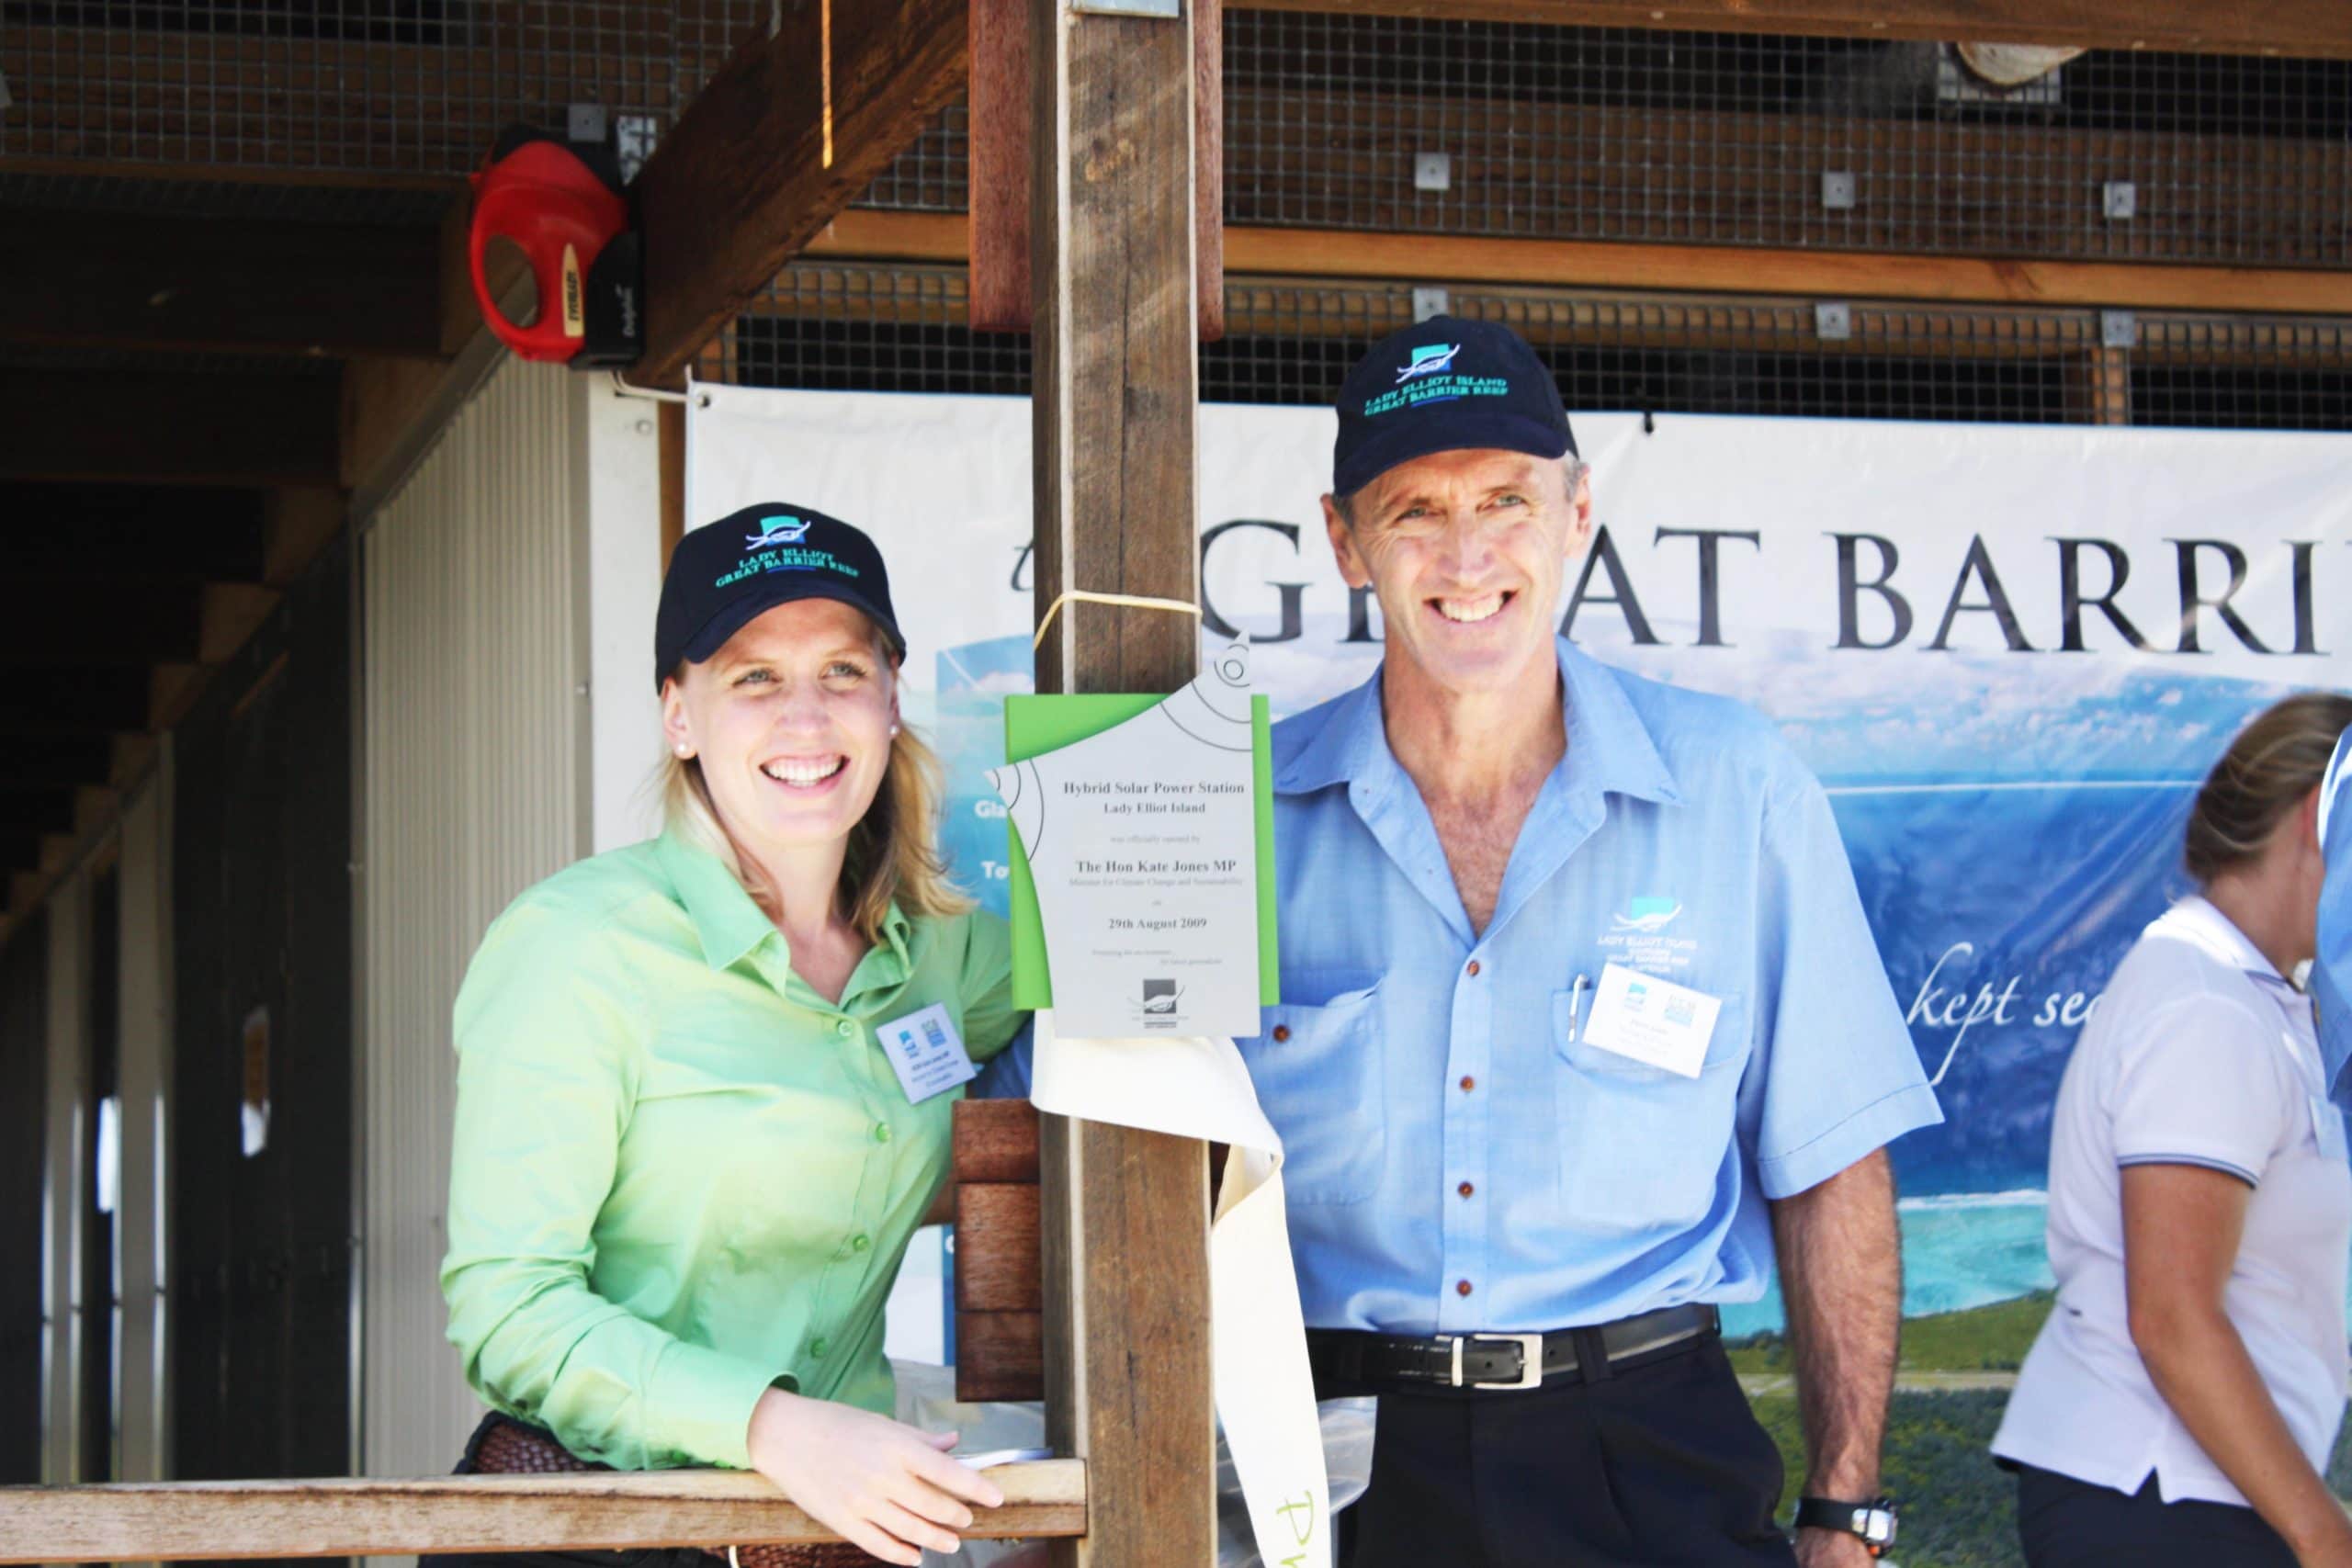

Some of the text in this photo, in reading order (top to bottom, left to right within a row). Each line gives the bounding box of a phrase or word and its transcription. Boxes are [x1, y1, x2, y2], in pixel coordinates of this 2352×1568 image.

[1363, 386, 1509, 416] GREAT BARRIER REEF
[1365, 375, 1508, 407] LADY ELLIOT ISLAND
[739, 550, 776, 568] LADY
[715, 565, 761, 588] GREAT
[763, 557, 826, 569] BARRIER
[1201, 518, 2352, 656] GAT BARRI
[1063, 781, 1245, 798] Hybrid Solar Power Station
[1103, 802, 1206, 817] Lady Elliot Island
[1075, 860, 1237, 874] The Hon Kate Jones MP
[1108, 917, 1207, 931] 29th August 2009
[1905, 941, 2023, 1087] kept
